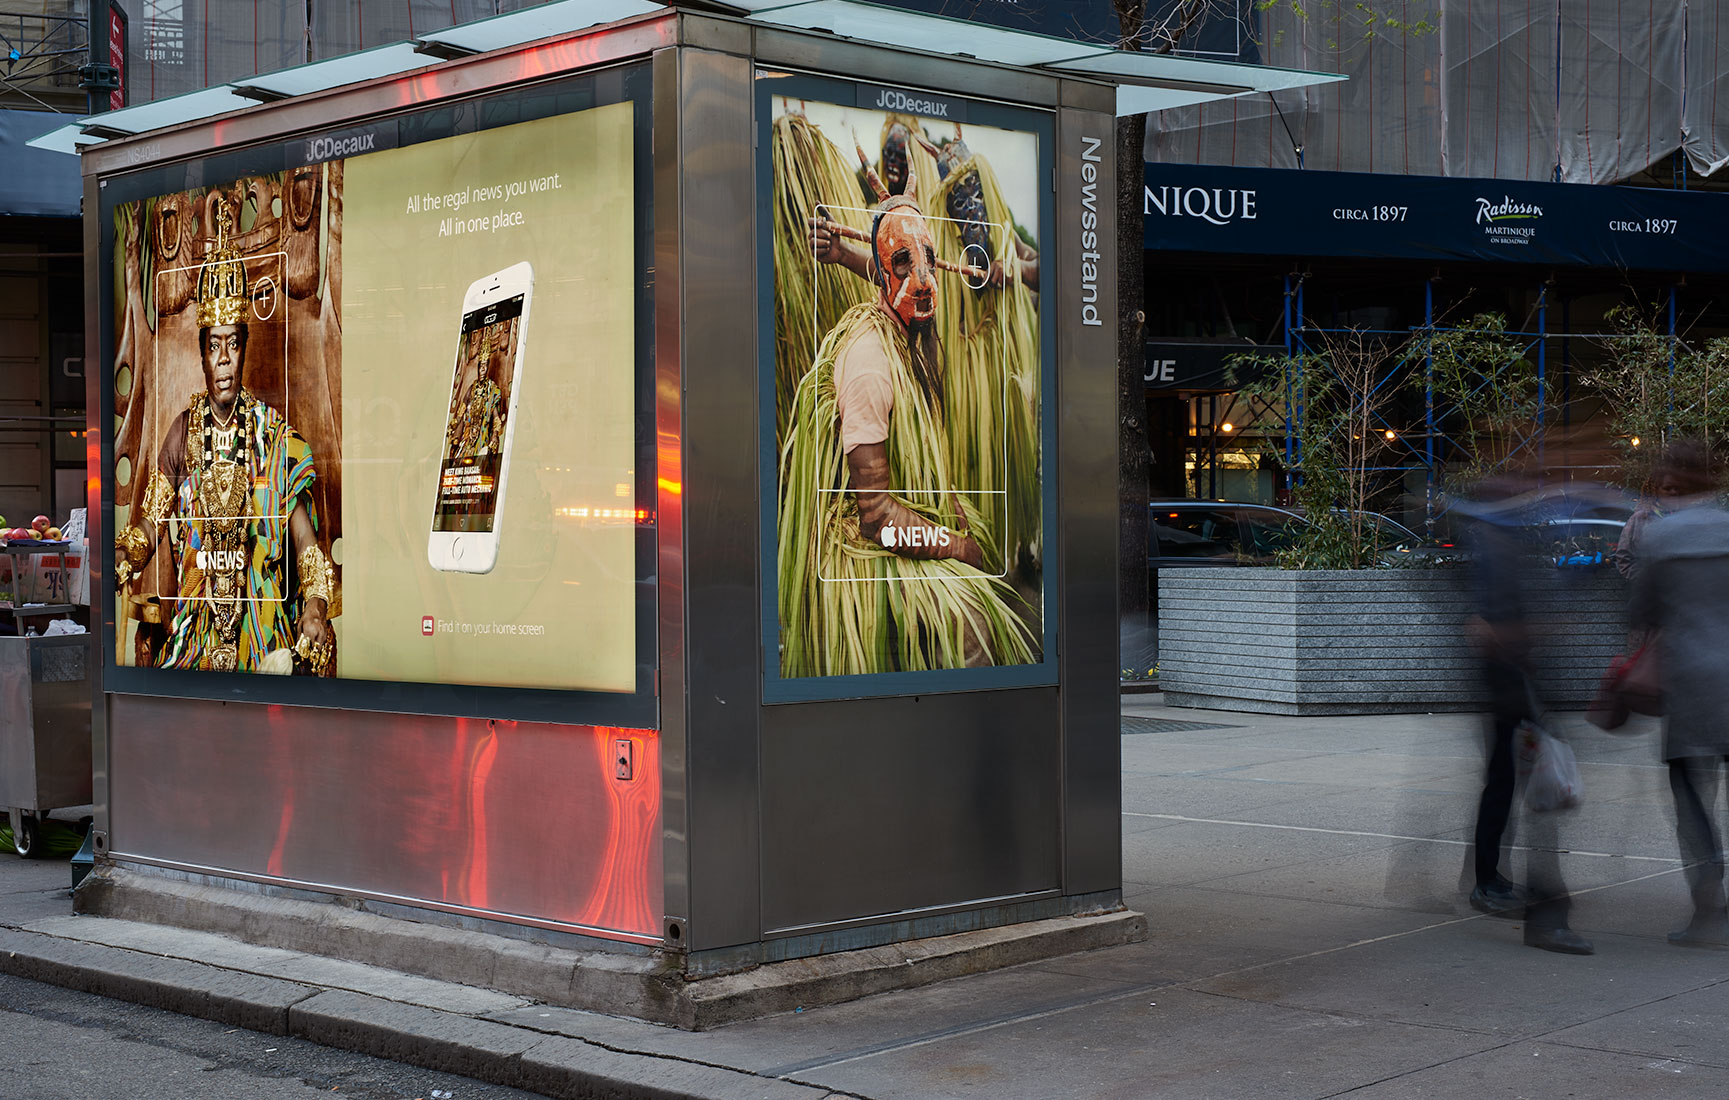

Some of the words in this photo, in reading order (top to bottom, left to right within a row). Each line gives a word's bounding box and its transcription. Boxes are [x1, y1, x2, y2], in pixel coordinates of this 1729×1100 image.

[875, 89, 948, 117] JCDecaux
[127, 143, 161, 164] NS4044
[306, 133, 375, 162] JCDecaux
[406, 195, 420, 214] All
[423, 193, 441, 211] the
[443, 186, 470, 211] regal
[473, 184, 502, 203] news
[505, 181, 527, 202] you
[530, 173, 562, 193] want.
[1143, 185, 1257, 226] NIQUE
[1333, 208, 1369, 221] CIRCA
[1372, 206, 1408, 222] 1897
[1475, 195, 1543, 225] Radisson
[438, 217, 453, 237] All
[455, 217, 465, 234] in
[467, 216, 489, 233] one
[492, 209, 525, 233] place.
[1081, 136, 1102, 326] Newsstand
[1485, 226, 1536, 237] MARTINIQUE
[1609, 220, 1643, 233] CIRCA
[1645, 218, 1678, 235] 1897
[898, 525, 950, 547] NEWS
[208, 550, 245, 570] NEWS
[437, 619, 454, 633] Find
[455, 621, 460, 632] it
[461, 622, 472, 633] on
[473, 623, 491, 637] your
[492, 621, 516, 634] home
[518, 623, 545, 635] screen
